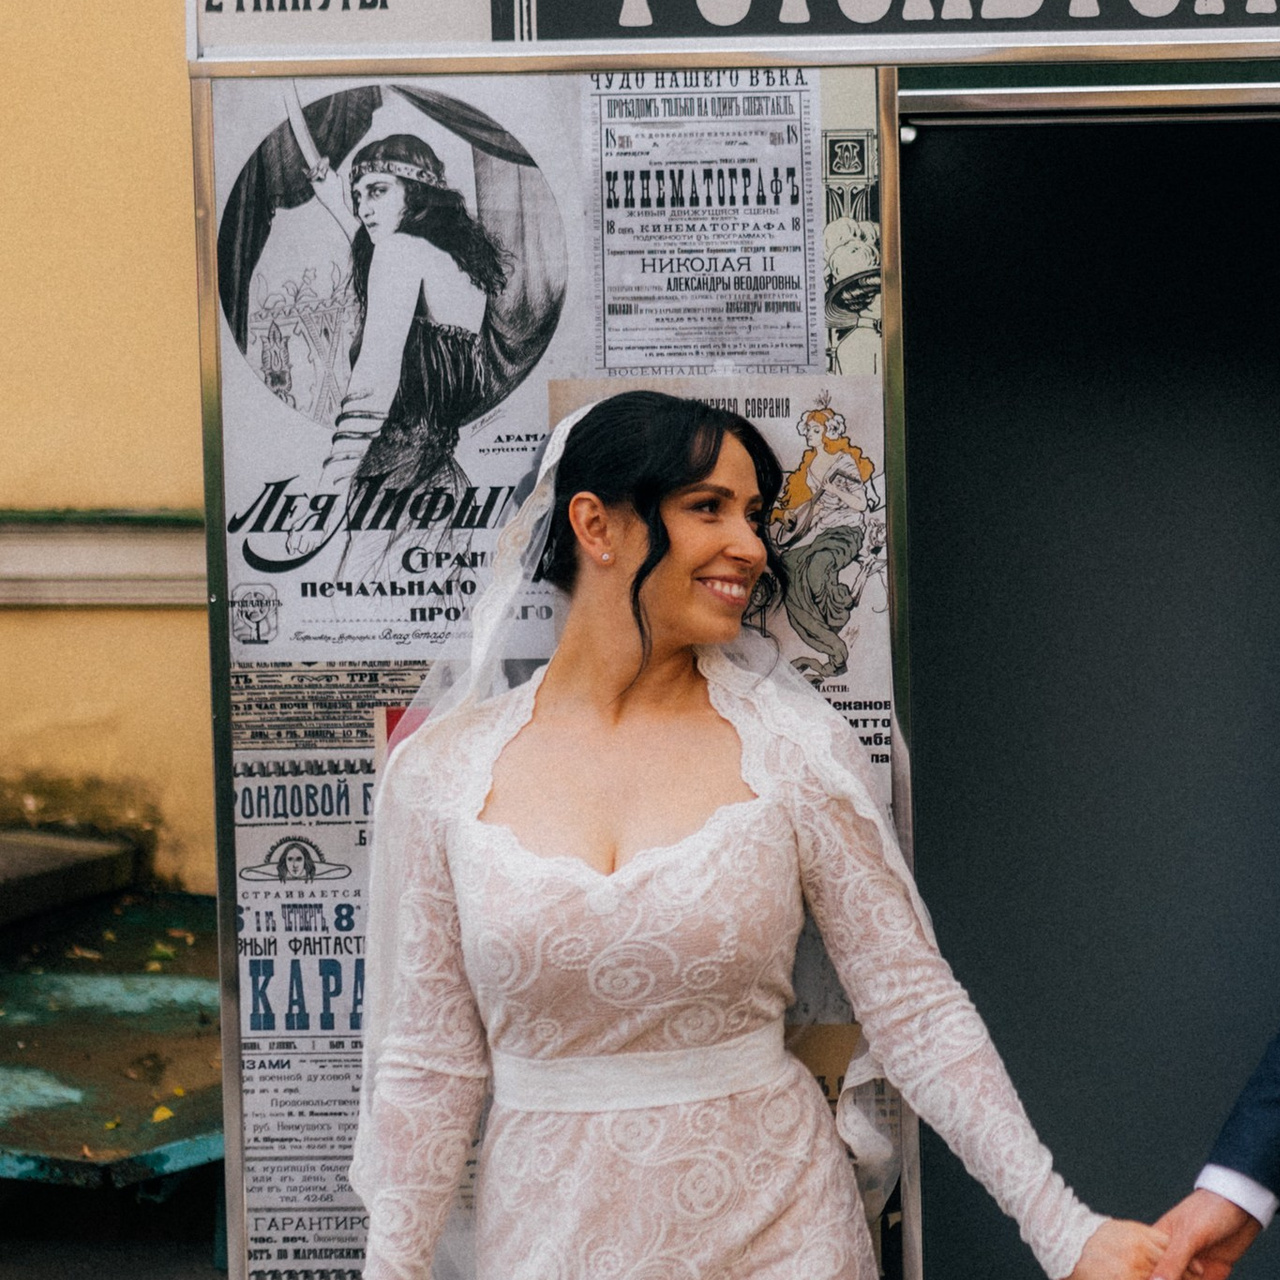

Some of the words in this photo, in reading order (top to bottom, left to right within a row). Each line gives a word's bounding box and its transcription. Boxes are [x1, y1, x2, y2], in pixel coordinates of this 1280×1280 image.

[590, 71, 645, 91] ЧУДО
[655, 71, 740, 89] НАШЕГО
[697, 96, 709, 117] НА
[605, 167, 800, 209] КИНЕМАТОГРАФЪ
[606, 220, 616, 235] 18
[640, 222, 786, 233] КИНЕМАТОГРАФА
[792, 217, 801, 231] 18
[641, 257, 751, 274] НИКОЛАЯ
[666, 276, 731, 293] АЛЕКСАНДРЫ
[401, 547, 490, 574] СТРАН
[825, 697, 892, 711] еканов
[843, 715, 892, 728] итто
[234, 778, 350, 819] ОНДОВОЙ
[241, 889, 362, 900] СТРАИВАЕТСЯ
[238, 935, 278, 957] ЗНЫЙ
[288, 935, 366, 956] ФАНТАСТ
[249, 958, 366, 1032] КАРА
[320, 1163, 350, 1172] билет
[253, 1216, 371, 1232] ГАРАНТИРО
